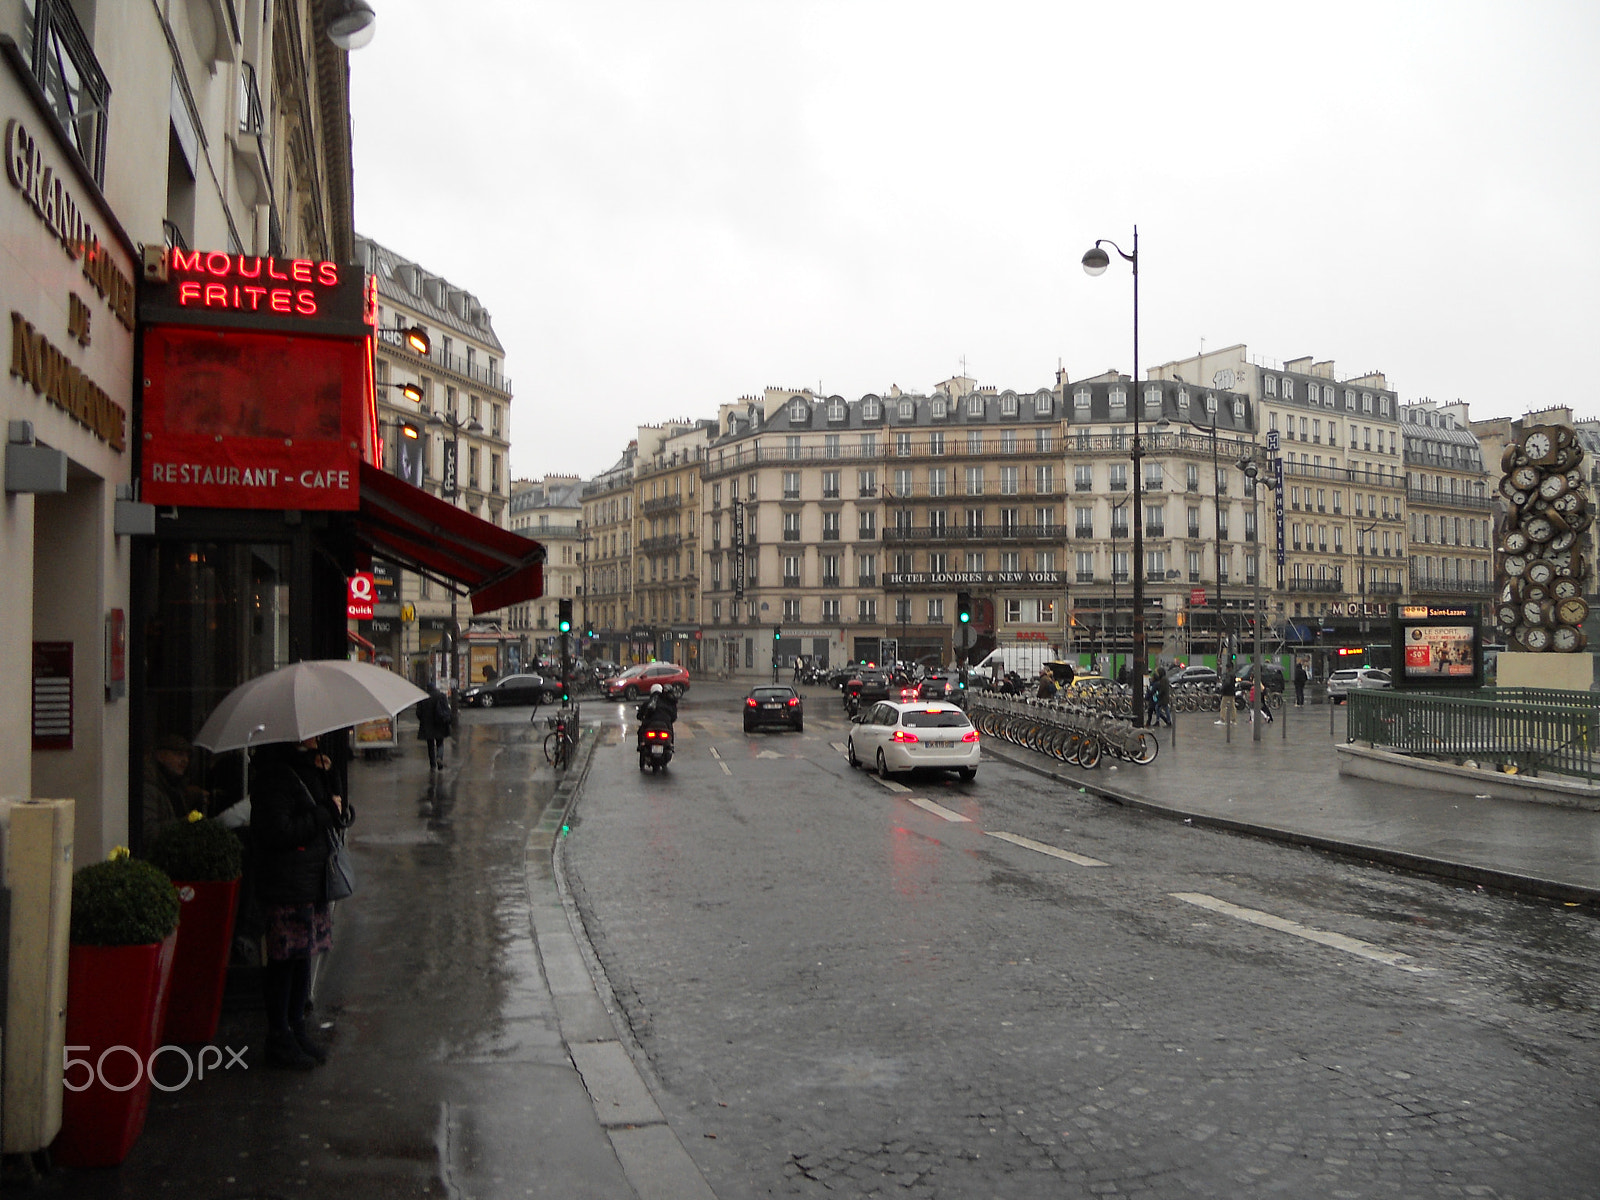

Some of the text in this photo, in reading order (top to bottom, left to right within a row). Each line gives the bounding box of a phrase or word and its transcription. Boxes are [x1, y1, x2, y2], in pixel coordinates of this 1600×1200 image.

[5, 118, 84, 262] GRAND
[173, 246, 339, 286] MOULES
[179, 282, 318, 315] FRITES
[67, 292, 92, 347] DE
[376, 331, 403, 346] nac
[10, 310, 126, 453] NORMANDIE
[152, 463, 280, 487] RESTAURANT
[300, 470, 351, 489] CAFE
[444, 448, 456, 492] fnac
[1276, 465, 1284, 550] TIMHOTEL
[351, 576, 372, 601] Q
[891, 573, 1058, 583] HOTEL LONDRES & NEW YORK
[348, 605, 372, 615] Quick
[1332, 603, 1387, 615] MOLL
[1429, 608, 1467, 616] Saint-Lazare
[372, 620, 391, 632] fnac
